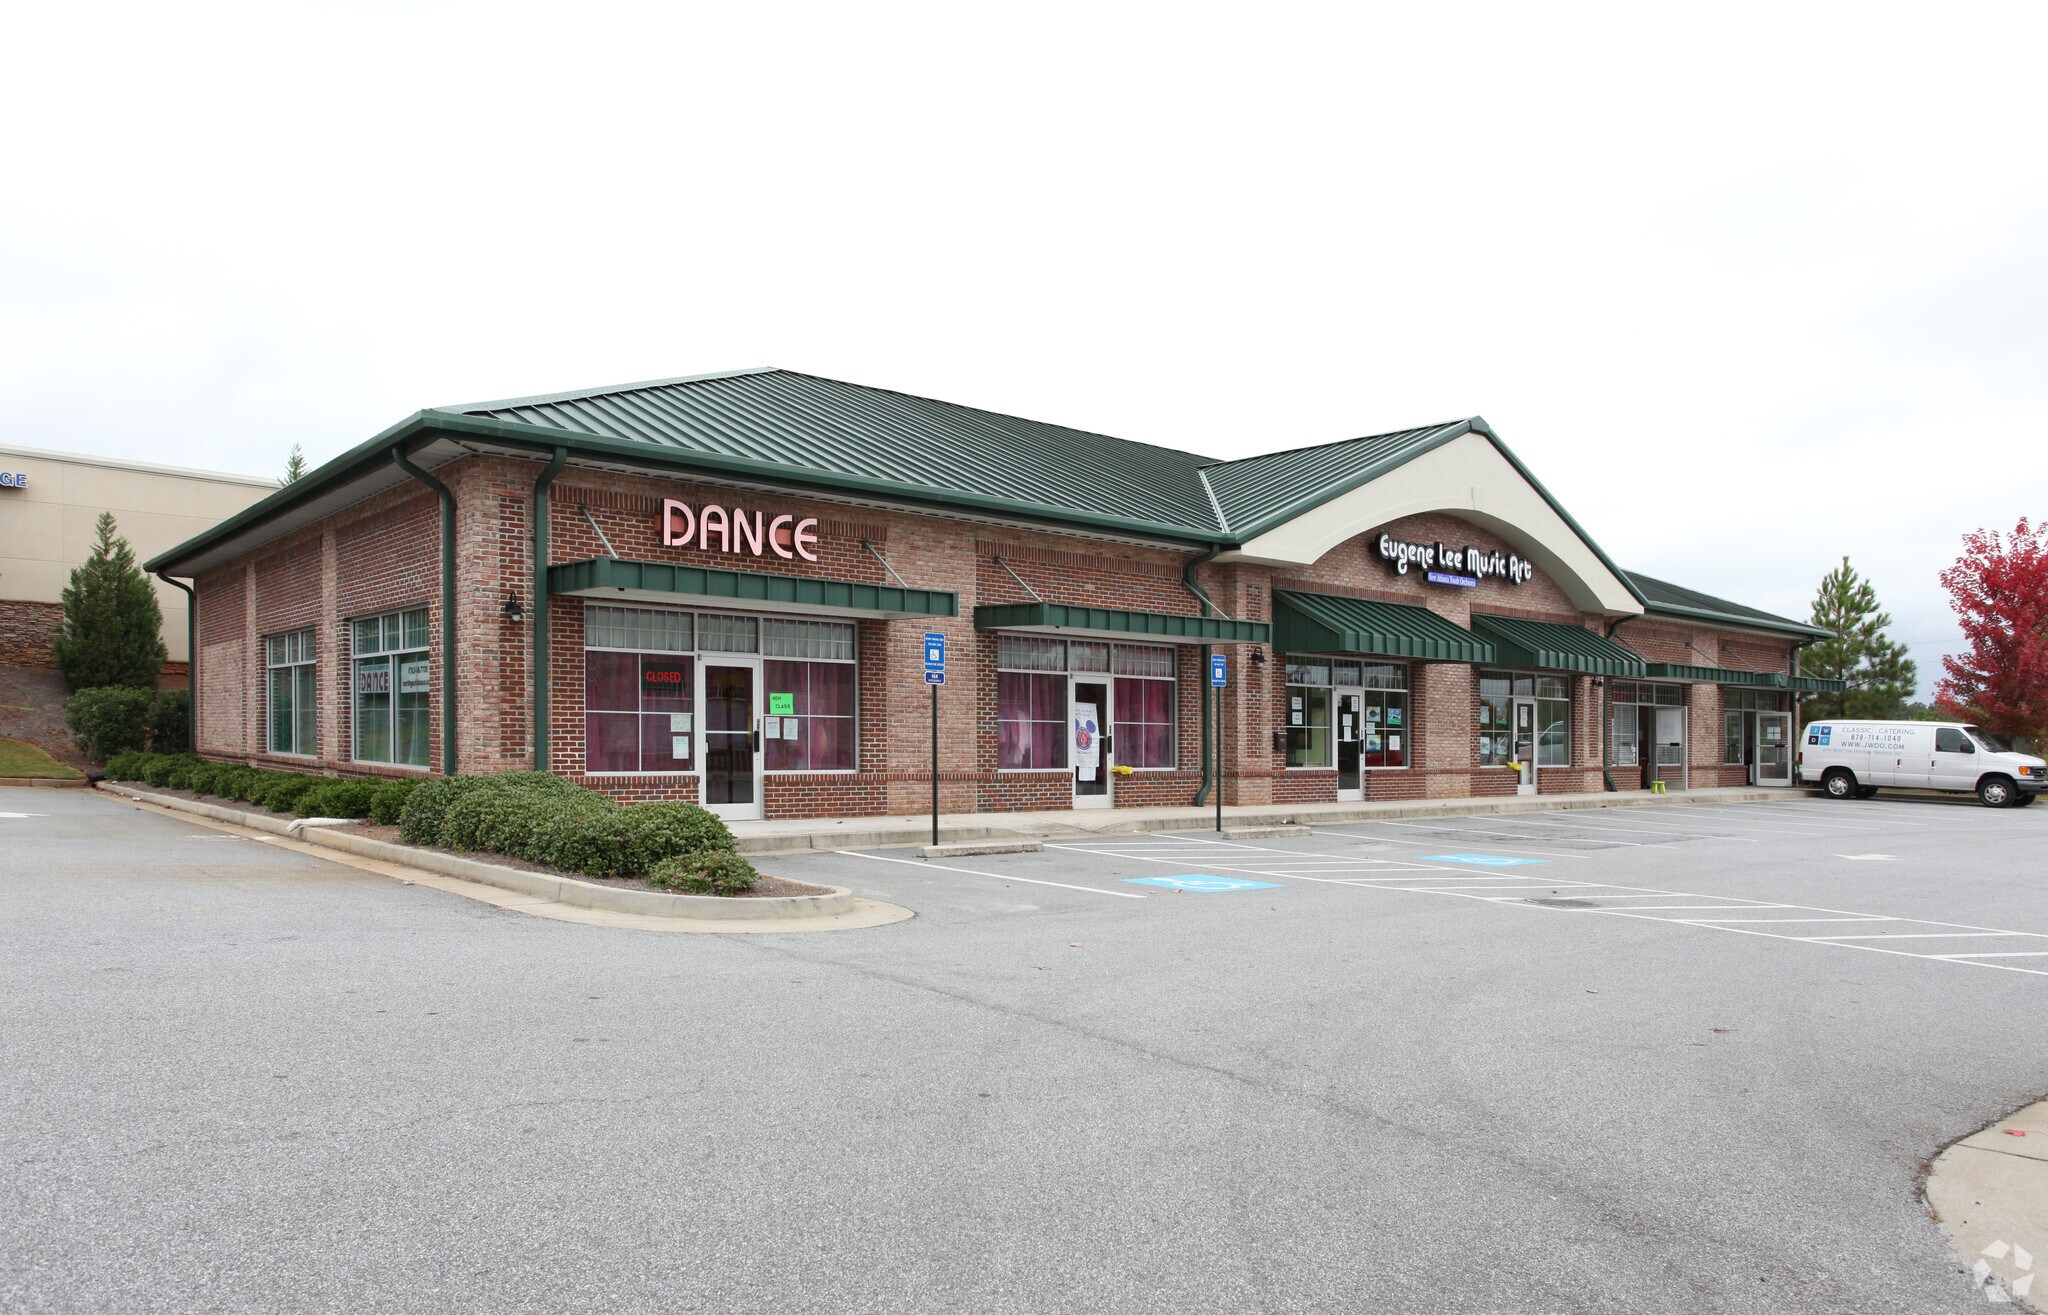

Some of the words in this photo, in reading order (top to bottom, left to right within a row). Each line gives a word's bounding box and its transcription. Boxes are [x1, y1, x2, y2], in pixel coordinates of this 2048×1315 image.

[663, 498, 818, 562] DANCE
[1379, 534, 1434, 575] Eugene
[1439, 543, 1463, 568] Lee
[1467, 548, 1506, 578] Music
[1509, 555, 1532, 584] Art
[361, 671, 389, 691] DANCE
[646, 671, 682, 682] CLOSED
[1841, 741, 1905, 749] WWW.JWDO.COM
